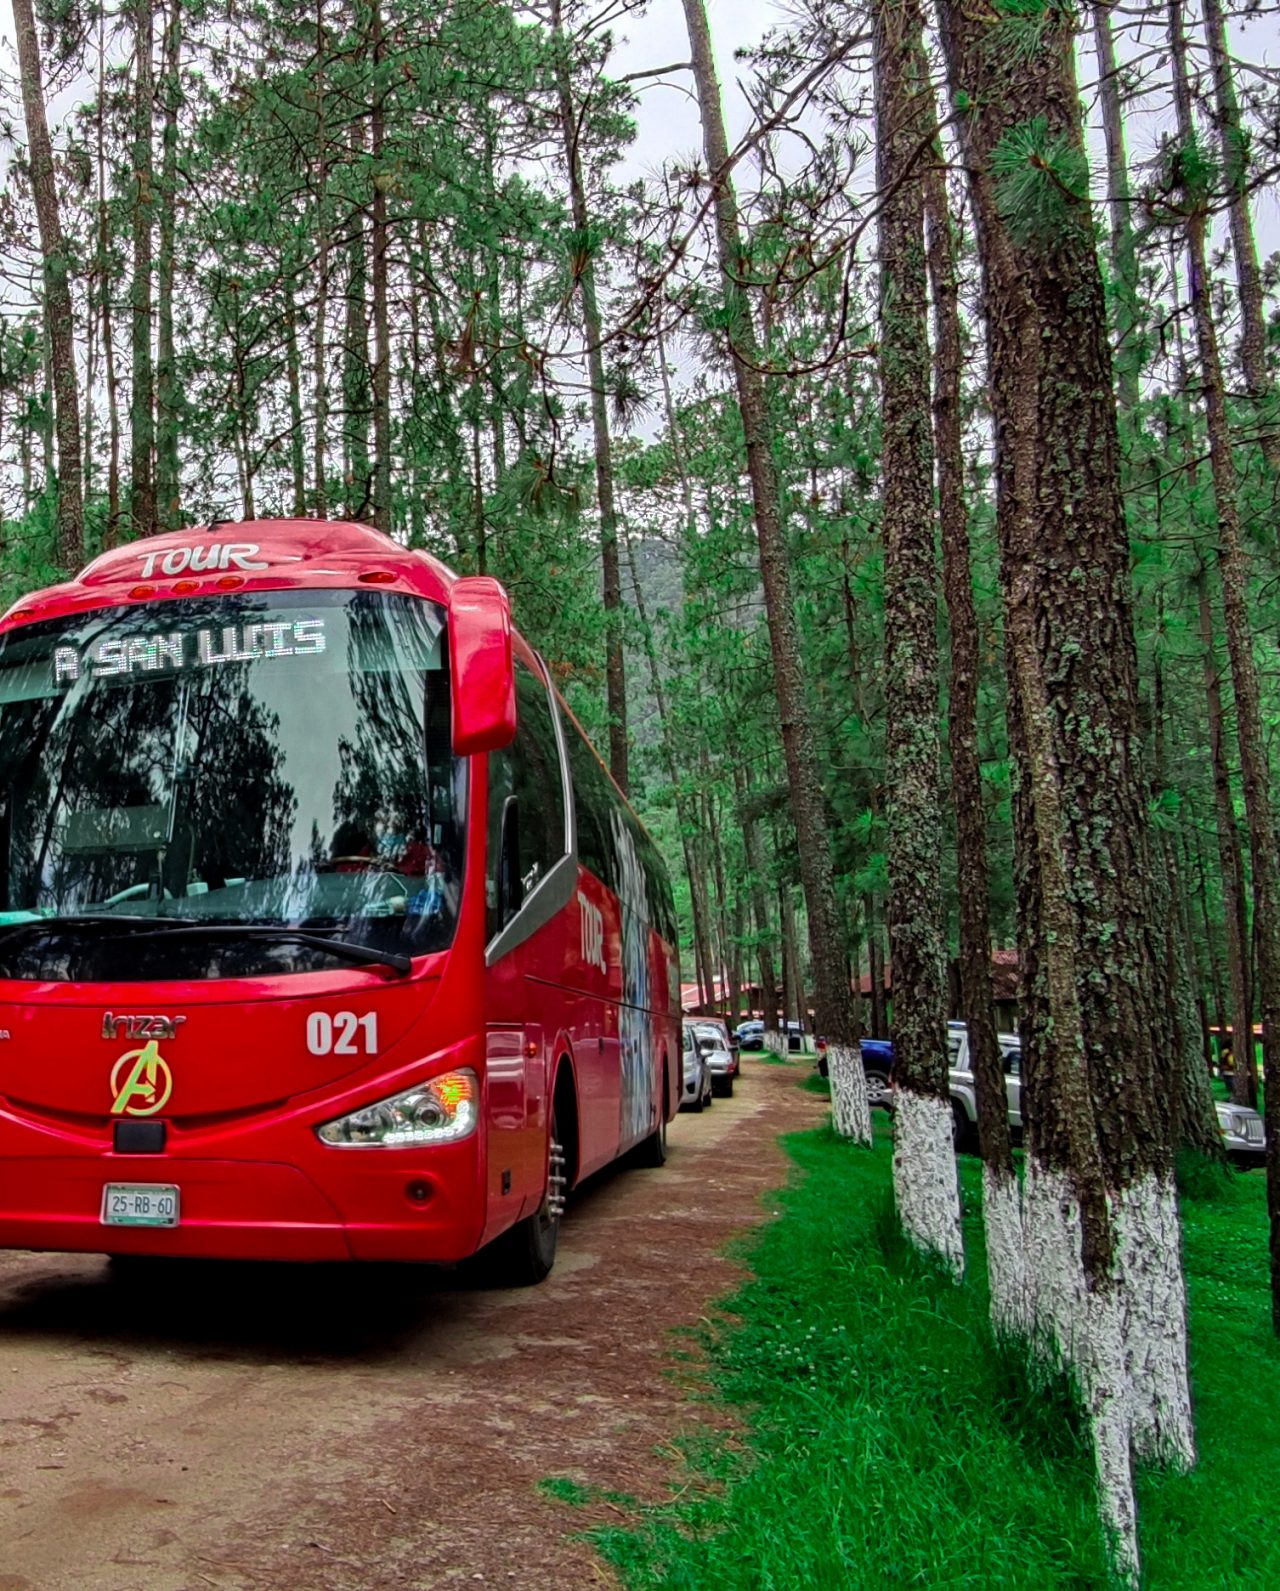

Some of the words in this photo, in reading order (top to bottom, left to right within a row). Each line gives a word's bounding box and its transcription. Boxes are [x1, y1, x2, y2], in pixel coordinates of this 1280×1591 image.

[137, 543, 269, 578] TOUR
[55, 646, 79, 682] A
[95, 632, 183, 677] SAN
[197, 619, 326, 664] LUIS
[306, 1011, 378, 1056] 021
